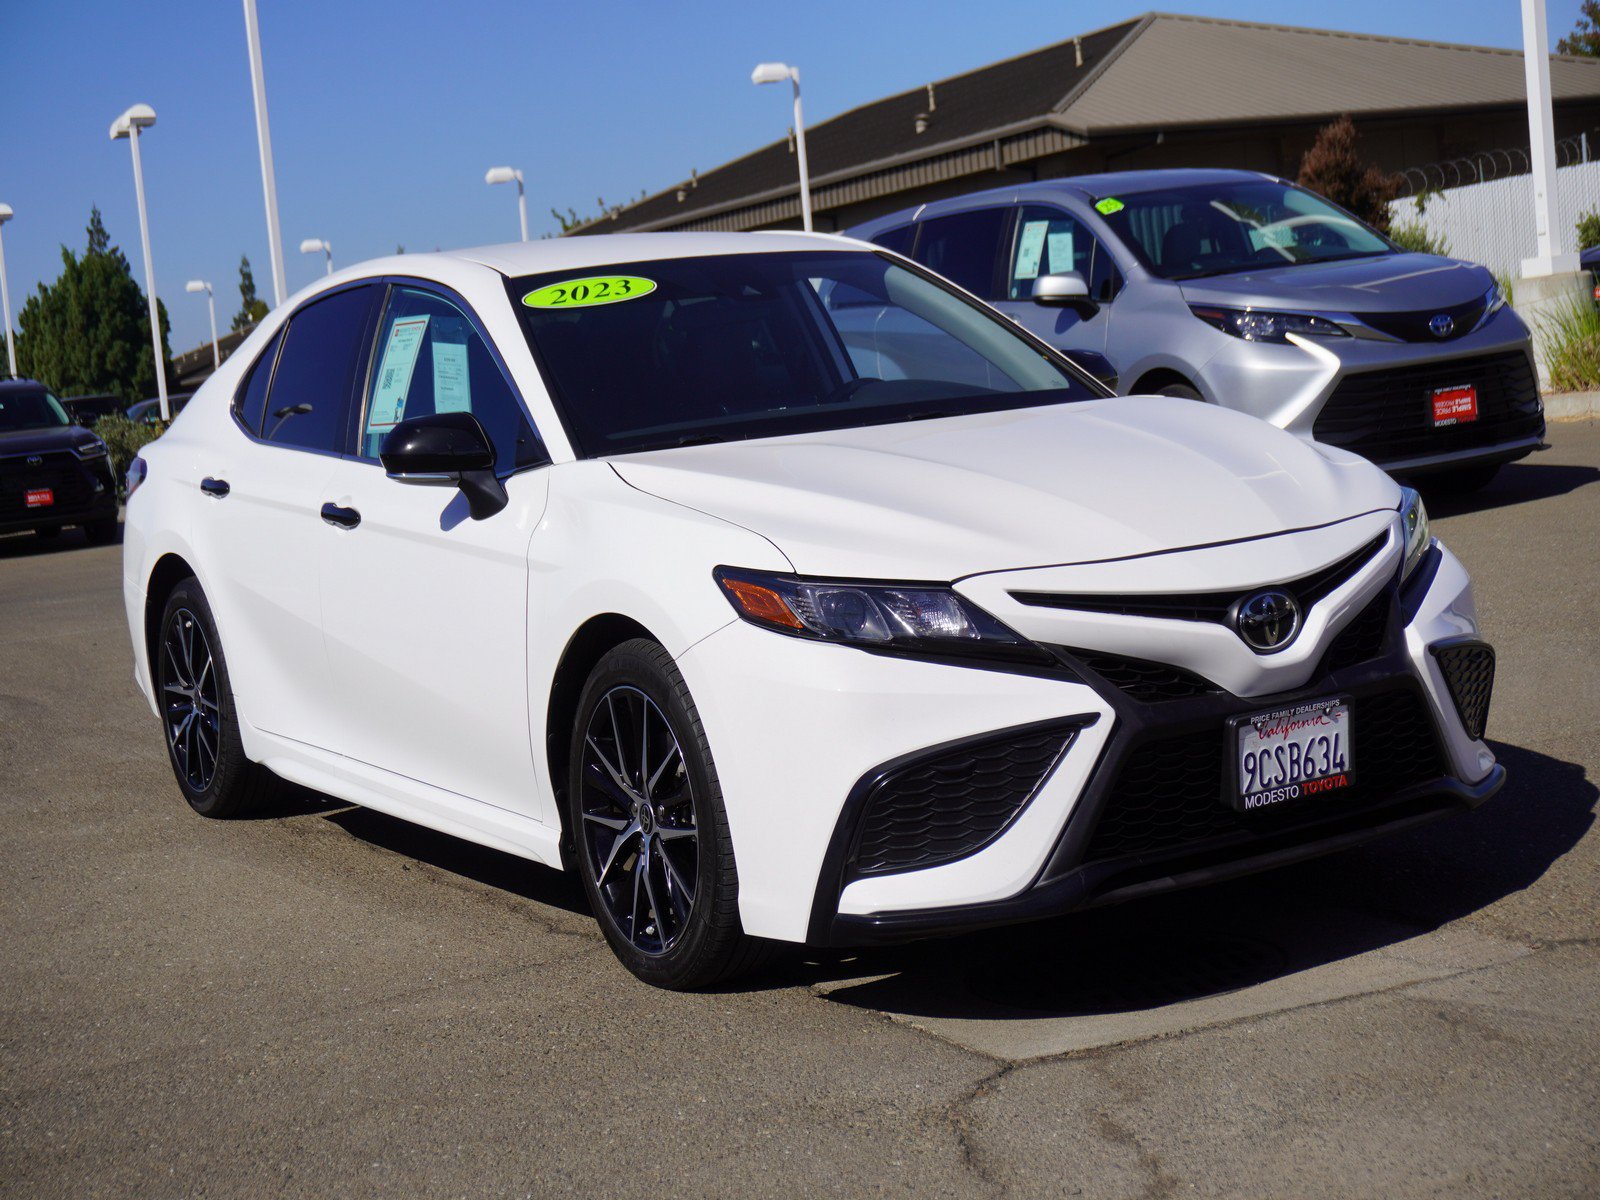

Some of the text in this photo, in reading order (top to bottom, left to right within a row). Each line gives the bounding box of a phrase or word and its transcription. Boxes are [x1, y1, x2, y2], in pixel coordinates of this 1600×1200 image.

[550, 279, 631, 305] 2023
[1250, 699, 1340, 725] PRICE FAMILY DEALERSHIPS
[1259, 714, 1330, 740] California
[1244, 732, 1346, 794] 9CSB634
[1245, 774, 1347, 810] MODESTO TOYOTA
